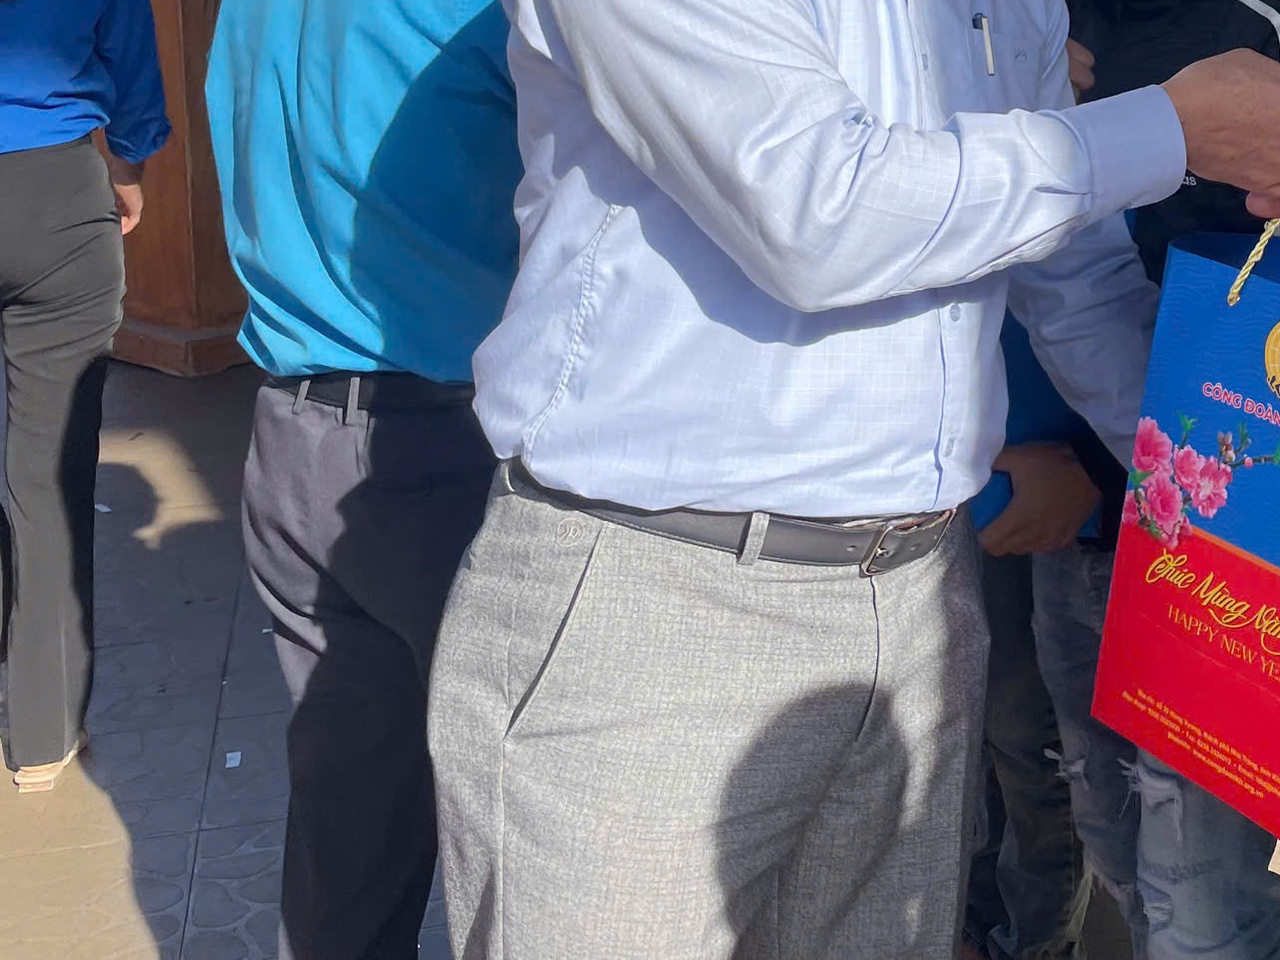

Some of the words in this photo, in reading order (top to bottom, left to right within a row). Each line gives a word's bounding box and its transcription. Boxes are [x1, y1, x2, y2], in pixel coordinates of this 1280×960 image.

[1203, 381, 1242, 408] CÔNG
[1146, 548, 1196, 589] Chúc
[1168, 604, 1219, 643] HAPPY
[1220, 634, 1258, 665] NEW
